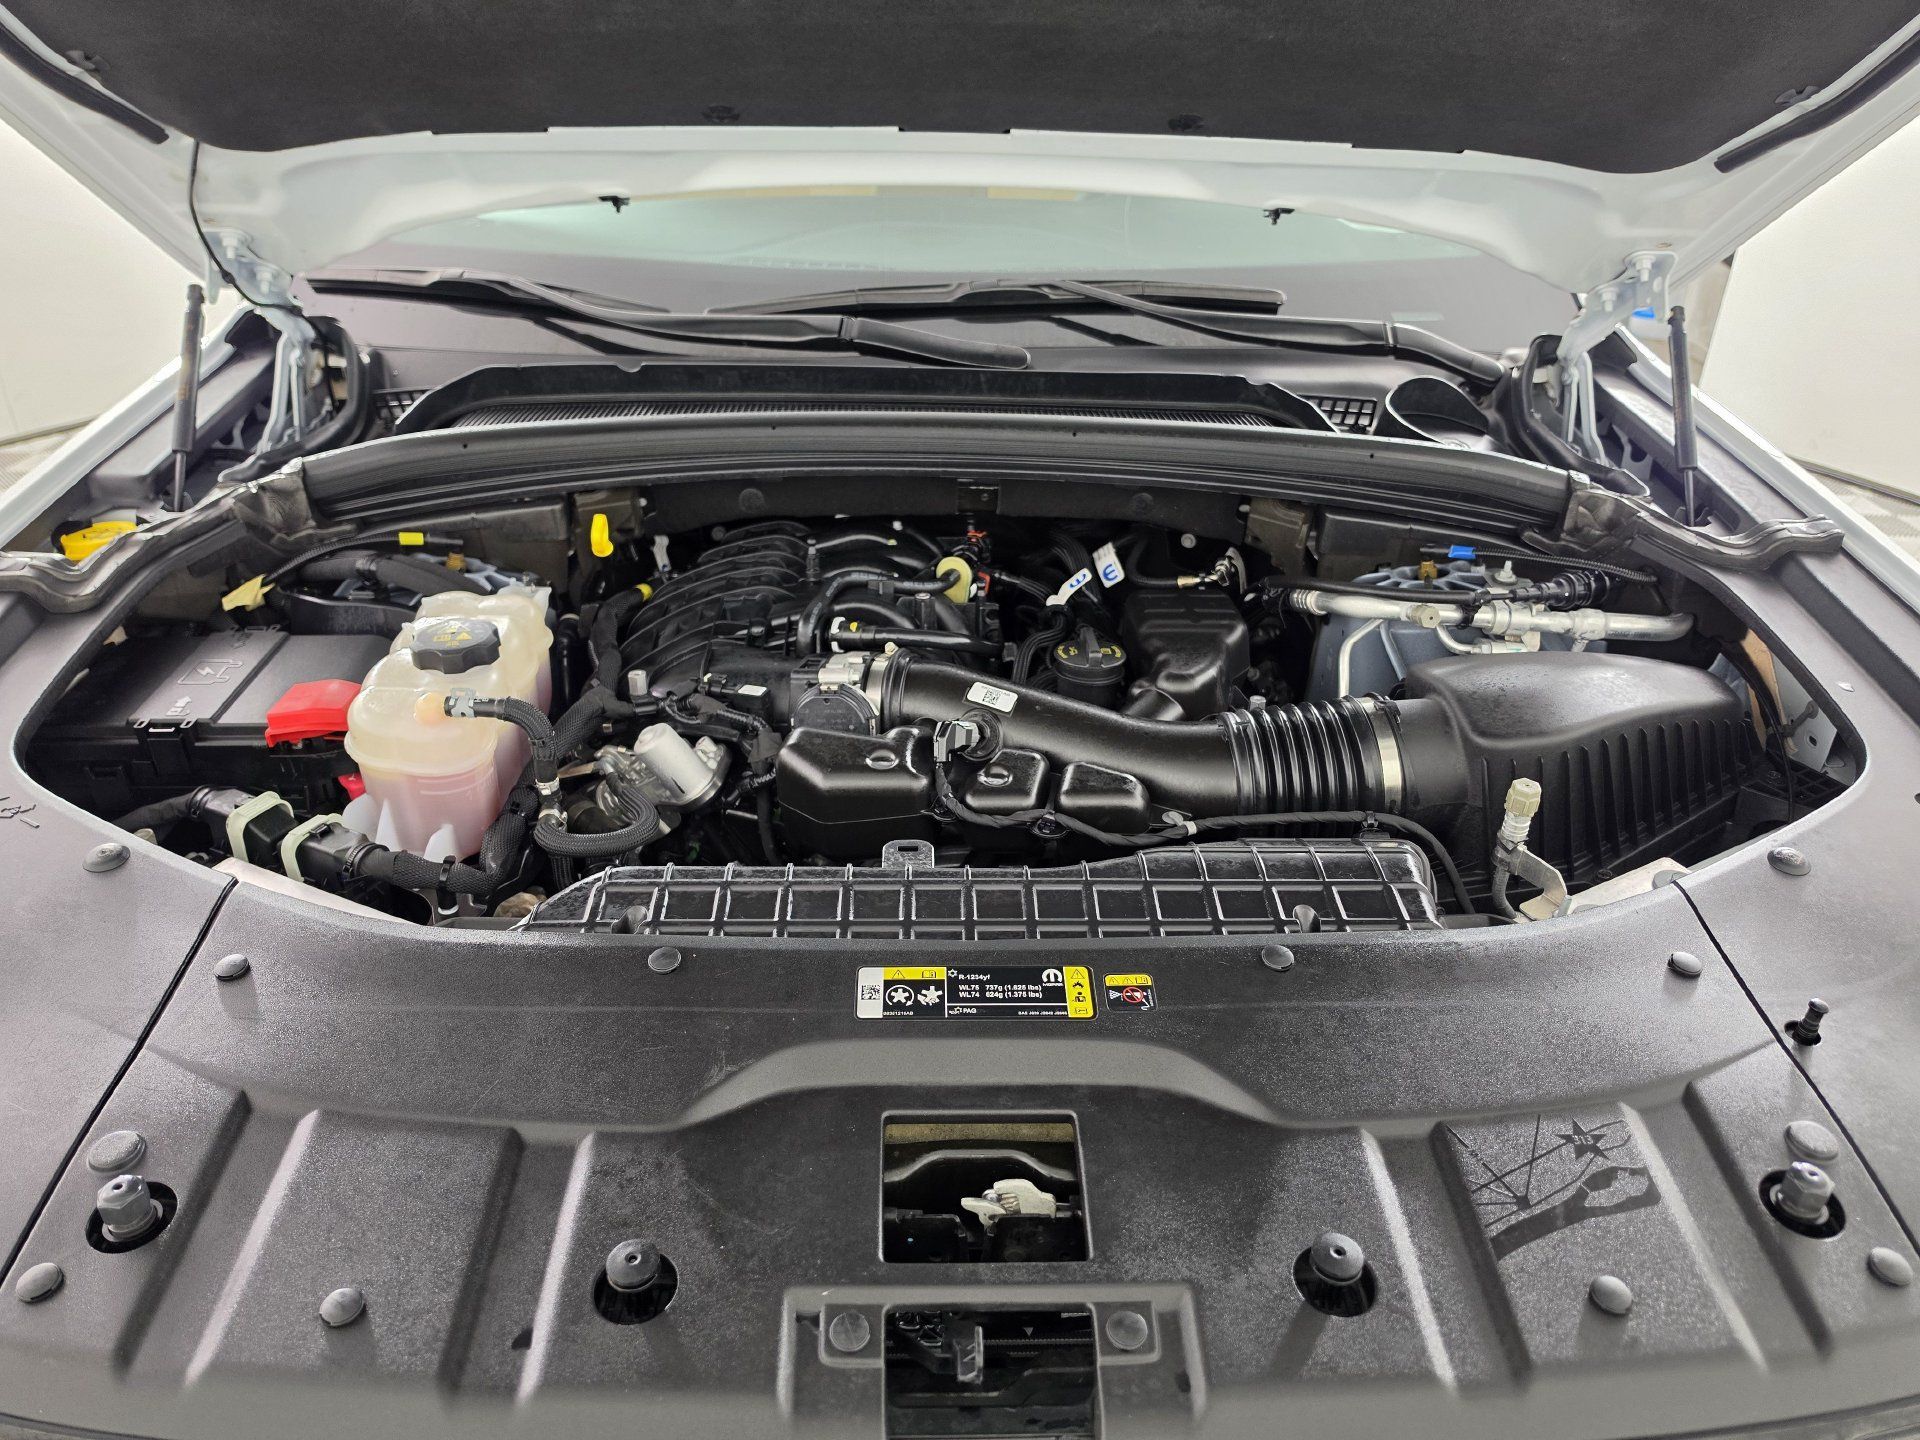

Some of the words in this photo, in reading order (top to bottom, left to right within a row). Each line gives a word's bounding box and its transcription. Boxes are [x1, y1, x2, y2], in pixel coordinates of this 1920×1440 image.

[985, 991, 1004, 999] 624g
[1004, 991, 1027, 999] (1.375
[1028, 991, 1043, 999] lbs)
[1572, 1134, 1594, 1145] 313
